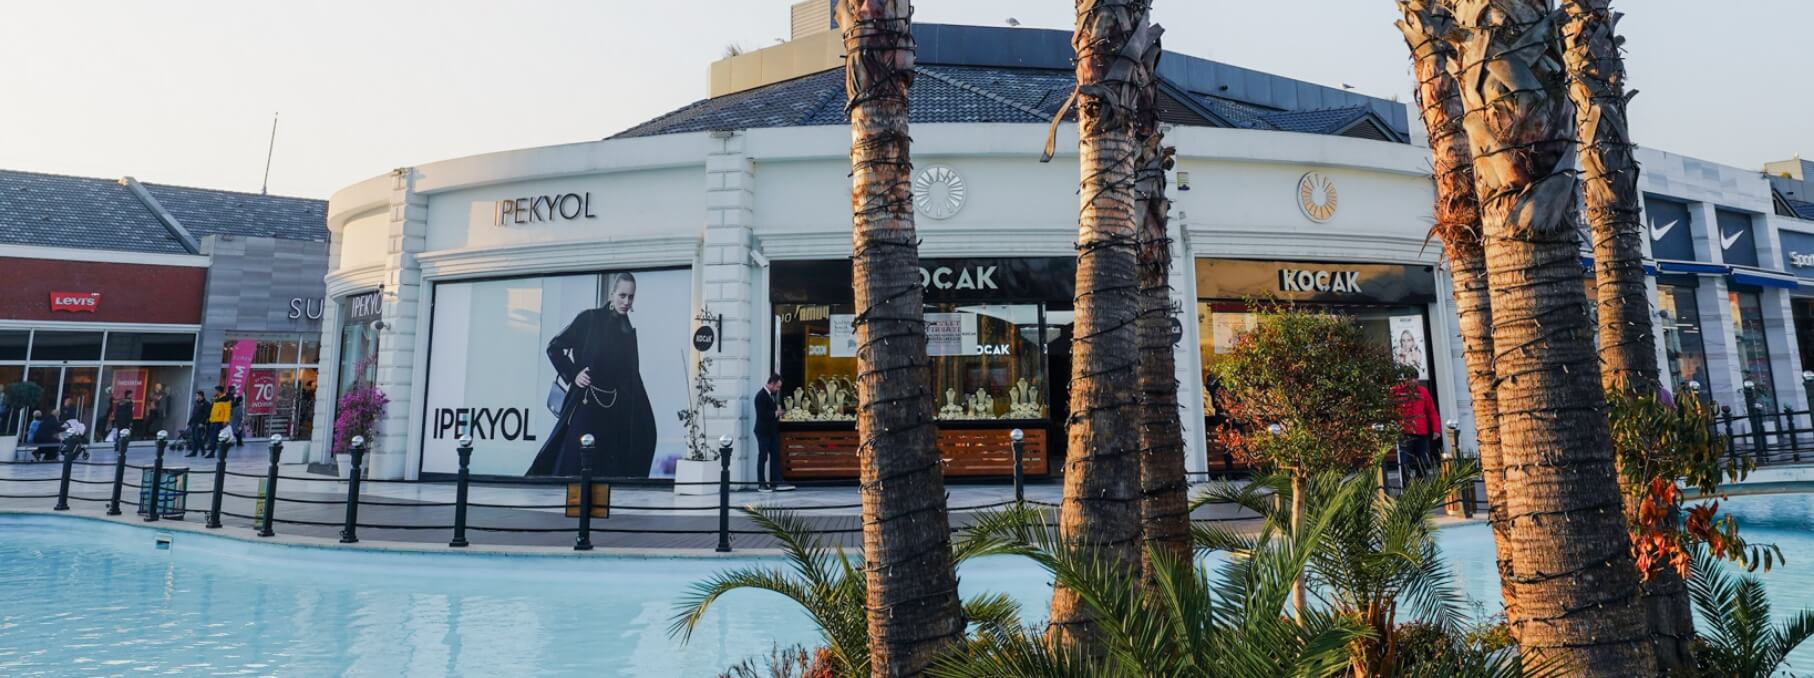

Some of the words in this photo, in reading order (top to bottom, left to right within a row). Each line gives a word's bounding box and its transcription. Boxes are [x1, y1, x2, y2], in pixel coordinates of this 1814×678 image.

[494, 192, 598, 226] IPEKYOL
[918, 265, 999, 290] OÇAK
[351, 291, 383, 318] IPEKYO
[432, 407, 537, 441] IPEKYOL
